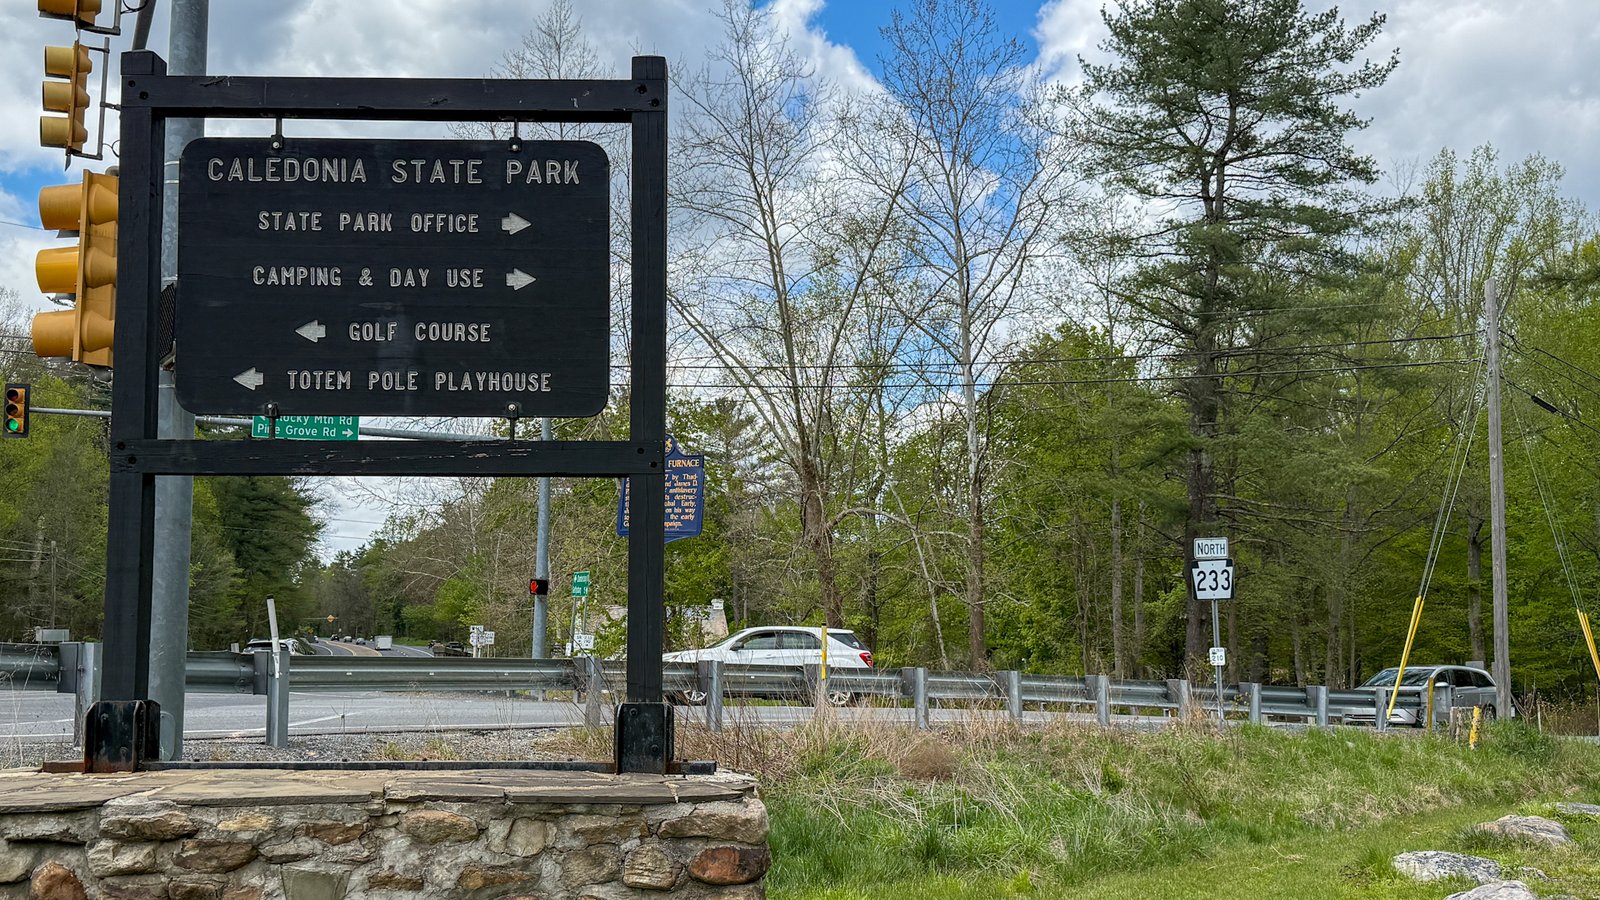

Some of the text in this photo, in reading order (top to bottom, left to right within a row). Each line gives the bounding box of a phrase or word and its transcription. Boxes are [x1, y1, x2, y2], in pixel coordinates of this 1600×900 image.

[207, 157, 580, 185] CALEDONIA STATE PARK
[258, 210, 479, 233] STATE PARK OFFICE
[252, 265, 484, 288] CAMPING & DAY USE
[348, 321, 491, 343] GOLF COURSE
[287, 370, 552, 392] TOTEM POLE PLAYHOUSE
[285, 425, 318, 436] Grove
[322, 427, 336, 437] Rd
[314, 416, 334, 424] Mtn
[339, 416, 353, 425] Rd
[668, 459, 700, 468] FURNACE
[671, 473, 679, 481] by
[1197, 542, 1226, 555] NORTH
[1196, 568, 1231, 592] 233
